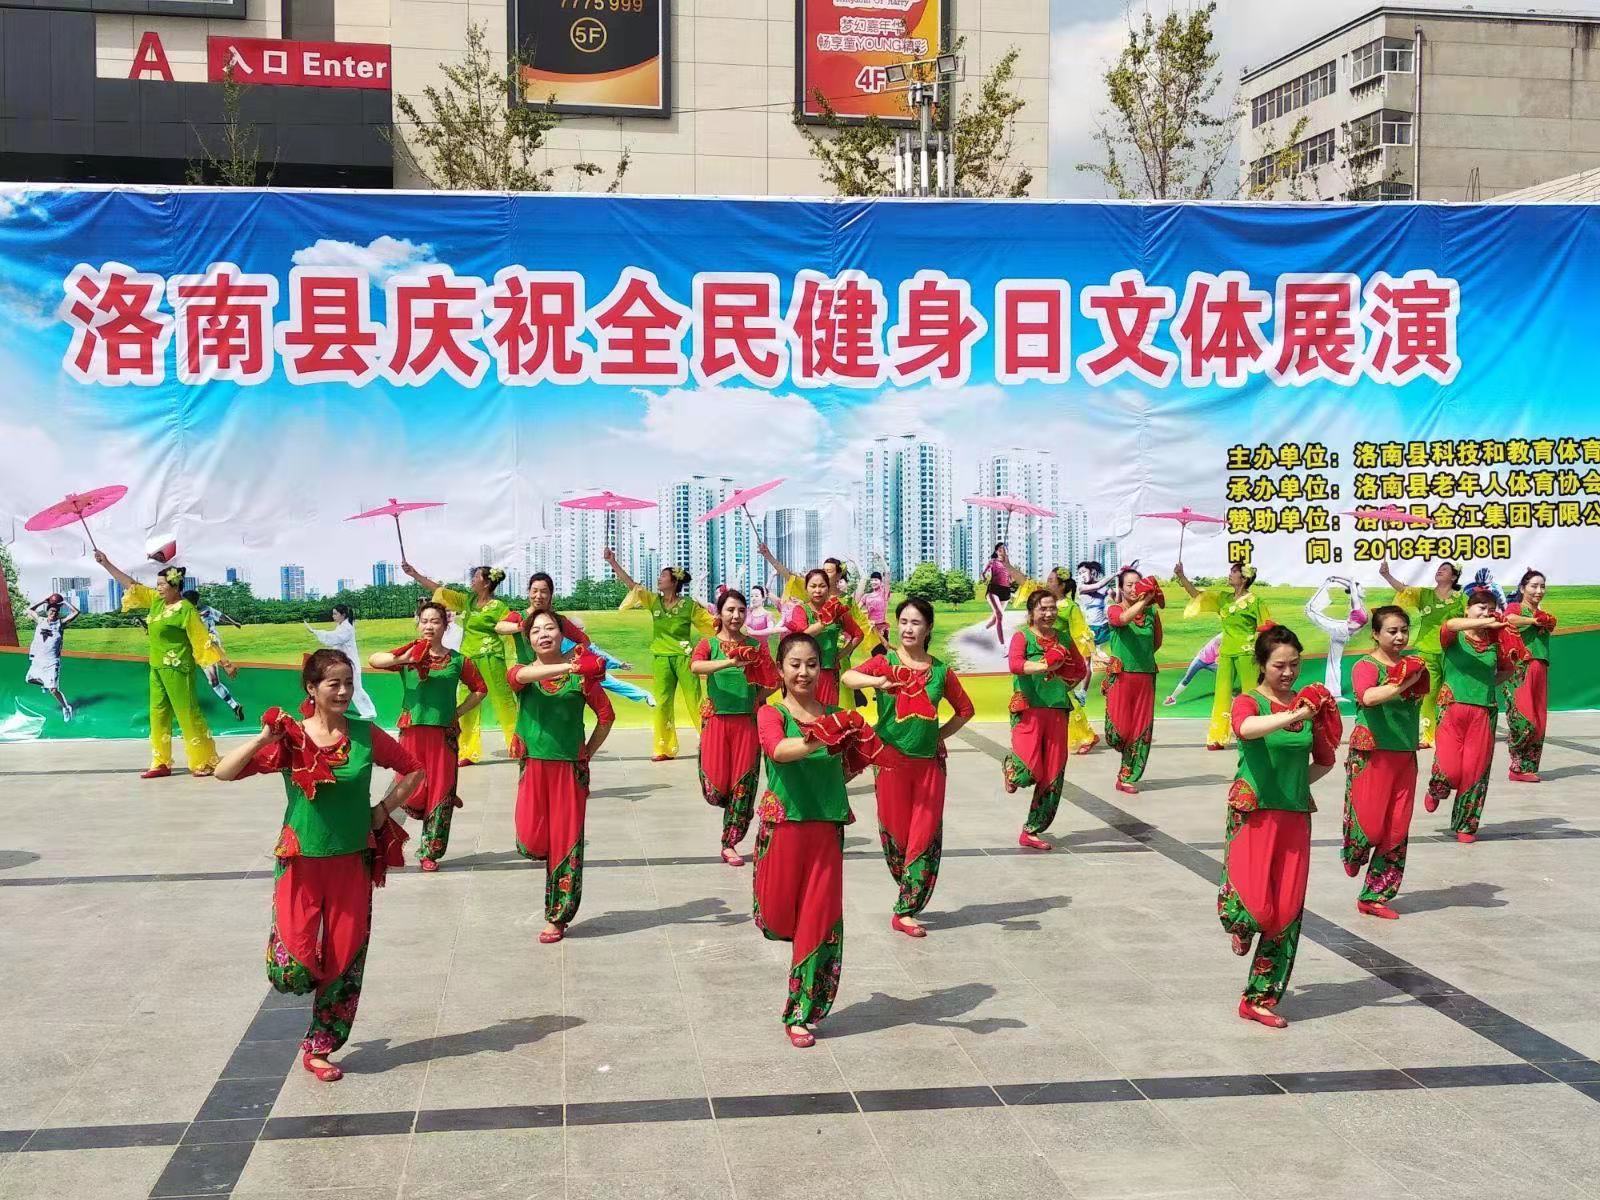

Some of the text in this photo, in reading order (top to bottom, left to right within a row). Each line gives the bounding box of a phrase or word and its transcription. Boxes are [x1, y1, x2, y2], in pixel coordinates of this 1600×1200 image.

[575, 27, 601, 43] 5F
[129, 32, 174, 81] A
[222, 45, 387, 79] 入口 Enter
[857, 67, 887, 91] 4F
[70, 272, 1450, 379] 洛南县庆祝全民健身日文体展演
